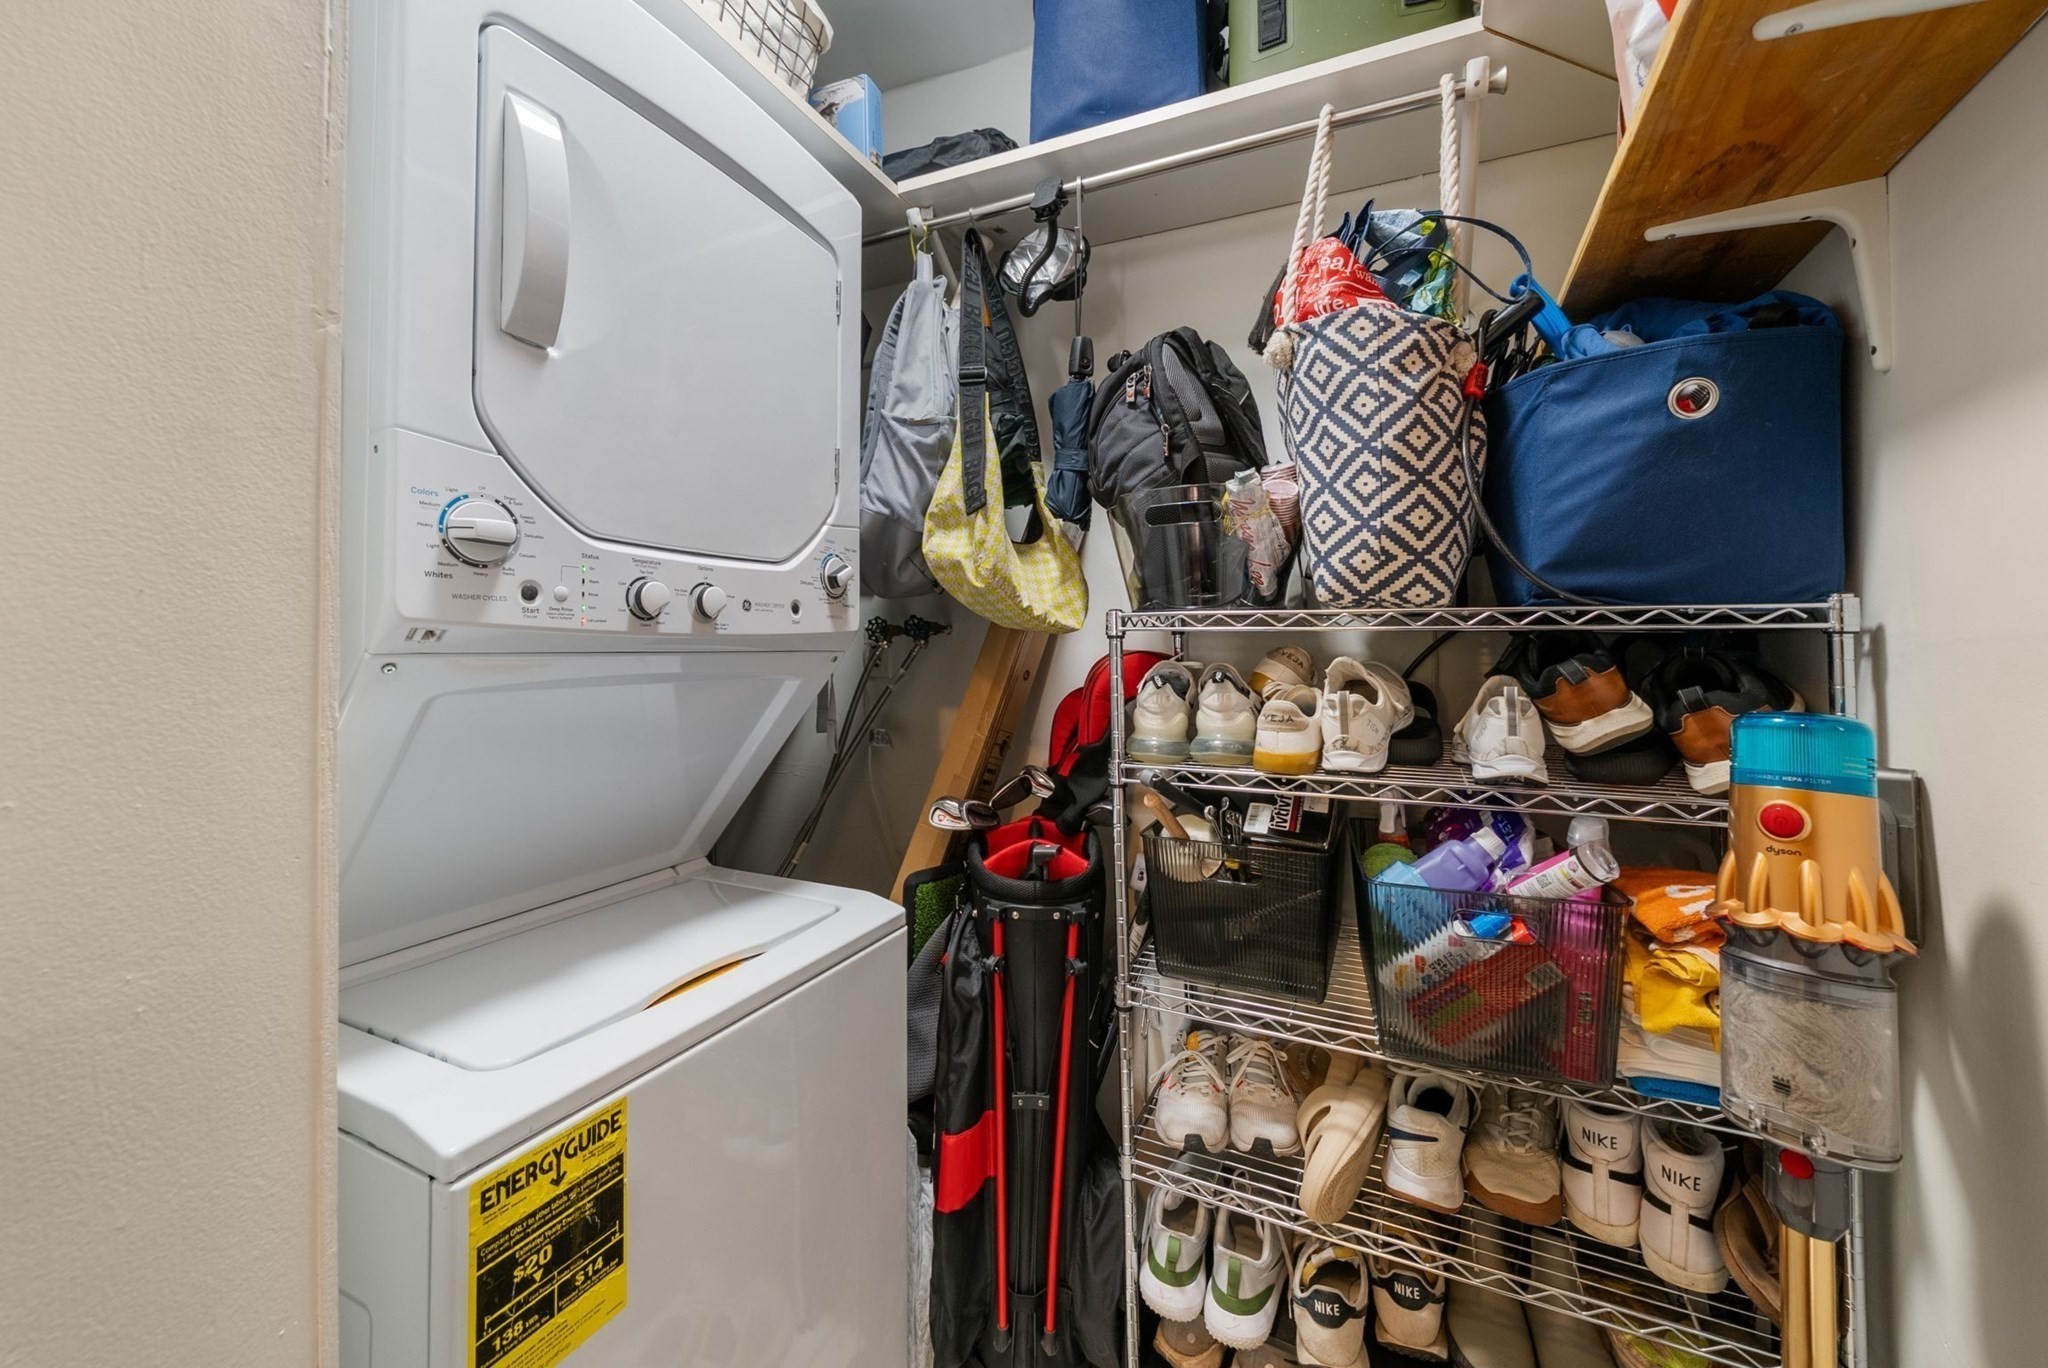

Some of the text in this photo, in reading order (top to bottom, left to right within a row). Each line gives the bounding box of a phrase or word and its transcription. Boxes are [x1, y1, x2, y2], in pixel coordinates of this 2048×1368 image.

[411, 486, 439, 497] Colors
[581, 552, 600, 560] Status
[631, 557, 662, 566] Temperature
[424, 570, 454, 579] Whites
[451, 593, 509, 602] WASHER CYCLES
[1281, 650, 1305, 669] VEJA
[1262, 713, 1295, 723] VEJA
[1781, 775, 1803, 783] HEPA
[1804, 777, 1832, 785] FILTER
[1765, 845, 1802, 856] dyson
[1581, 1126, 1618, 1150] NIKE
[480, 1109, 622, 1215] ENERGYGUIDE
[1661, 1164, 1701, 1192] NIKE
[480, 1234, 509, 1257] Compare
[510, 1223, 527, 1237] ONLY
[513, 1243, 553, 1284] $20
[575, 1255, 604, 1287] $14
[1394, 1281, 1421, 1300] NIKE
[1314, 1299, 1341, 1316] NIKE
[491, 1319, 524, 1352] 138
